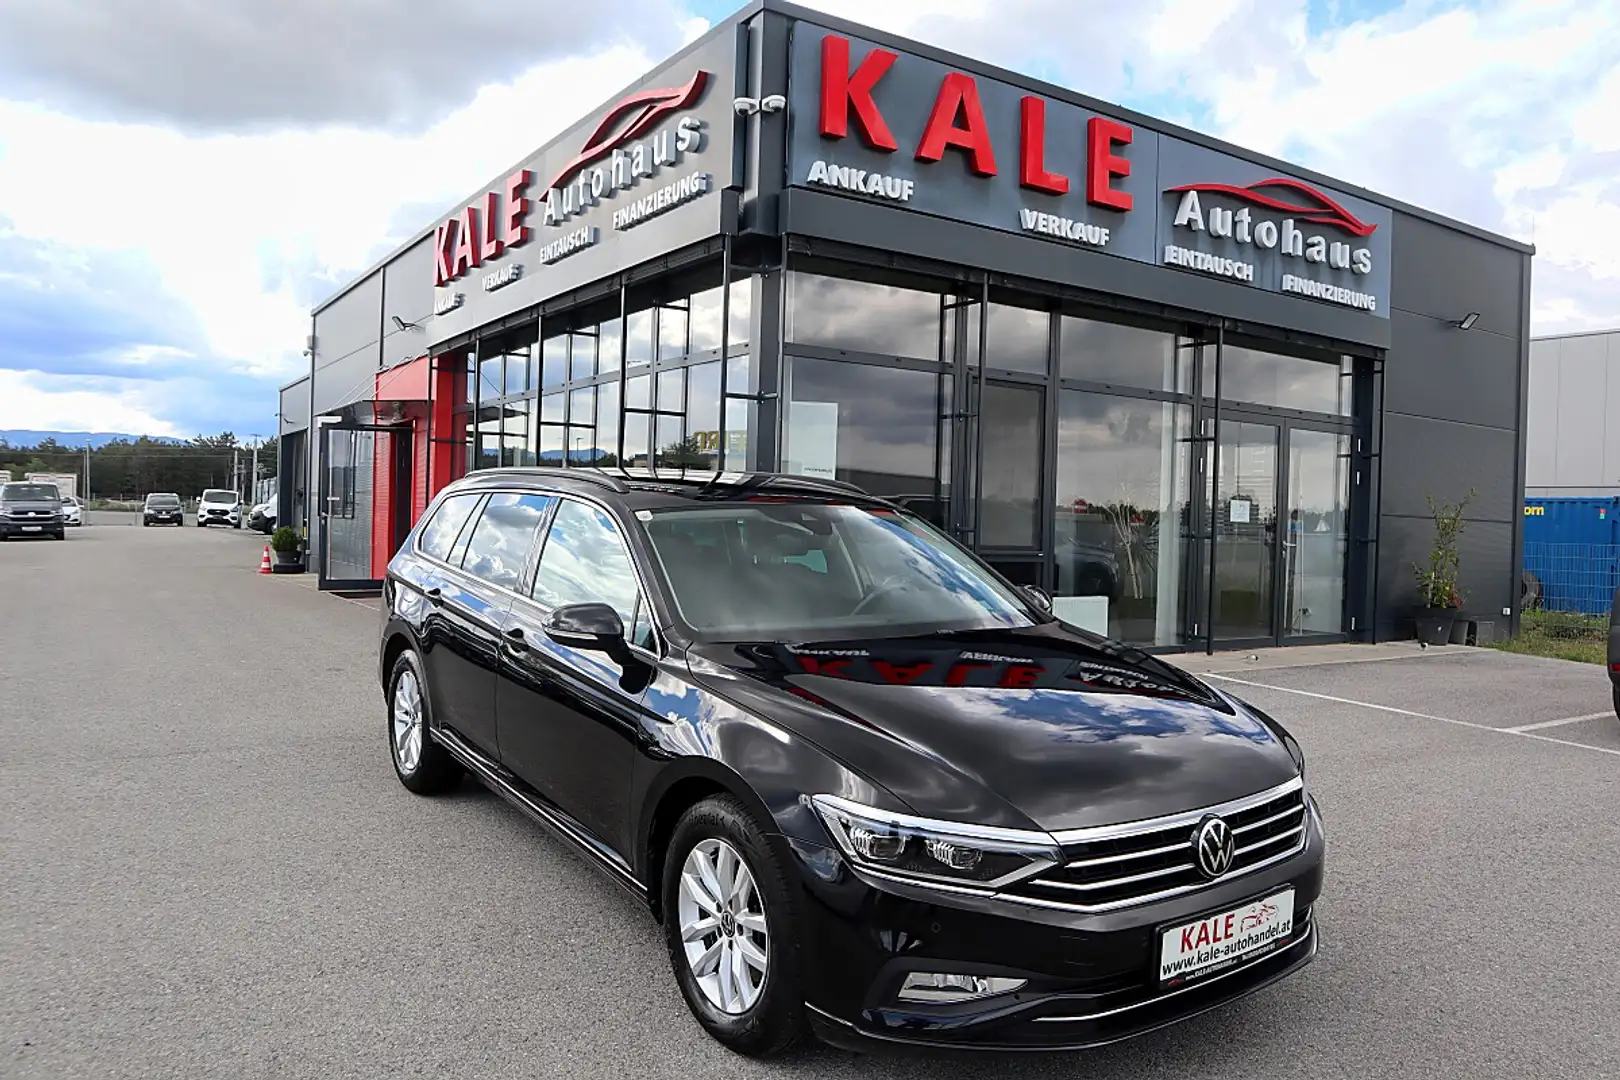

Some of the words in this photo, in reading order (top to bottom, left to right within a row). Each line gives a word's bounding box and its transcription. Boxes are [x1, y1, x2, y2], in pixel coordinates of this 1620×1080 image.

[819, 34, 1133, 212] KALE
[543, 116, 700, 225] Autohaus
[807, 160, 914, 201] ANKAUF
[612, 171, 707, 230] FINANZIERUNG
[433, 169, 530, 287] KALE
[540, 225, 595, 264] EINTAUSCH
[1019, 208, 1110, 246] VERKAUF
[1173, 190, 1372, 274] Autohaus
[1164, 245, 1254, 282] EINTAUSCH
[1282, 274, 1376, 311] FINANZIERUNG
[1162, 919, 1290, 976] www.kale-autohandel.at
[1180, 913, 1235, 953] KALE
